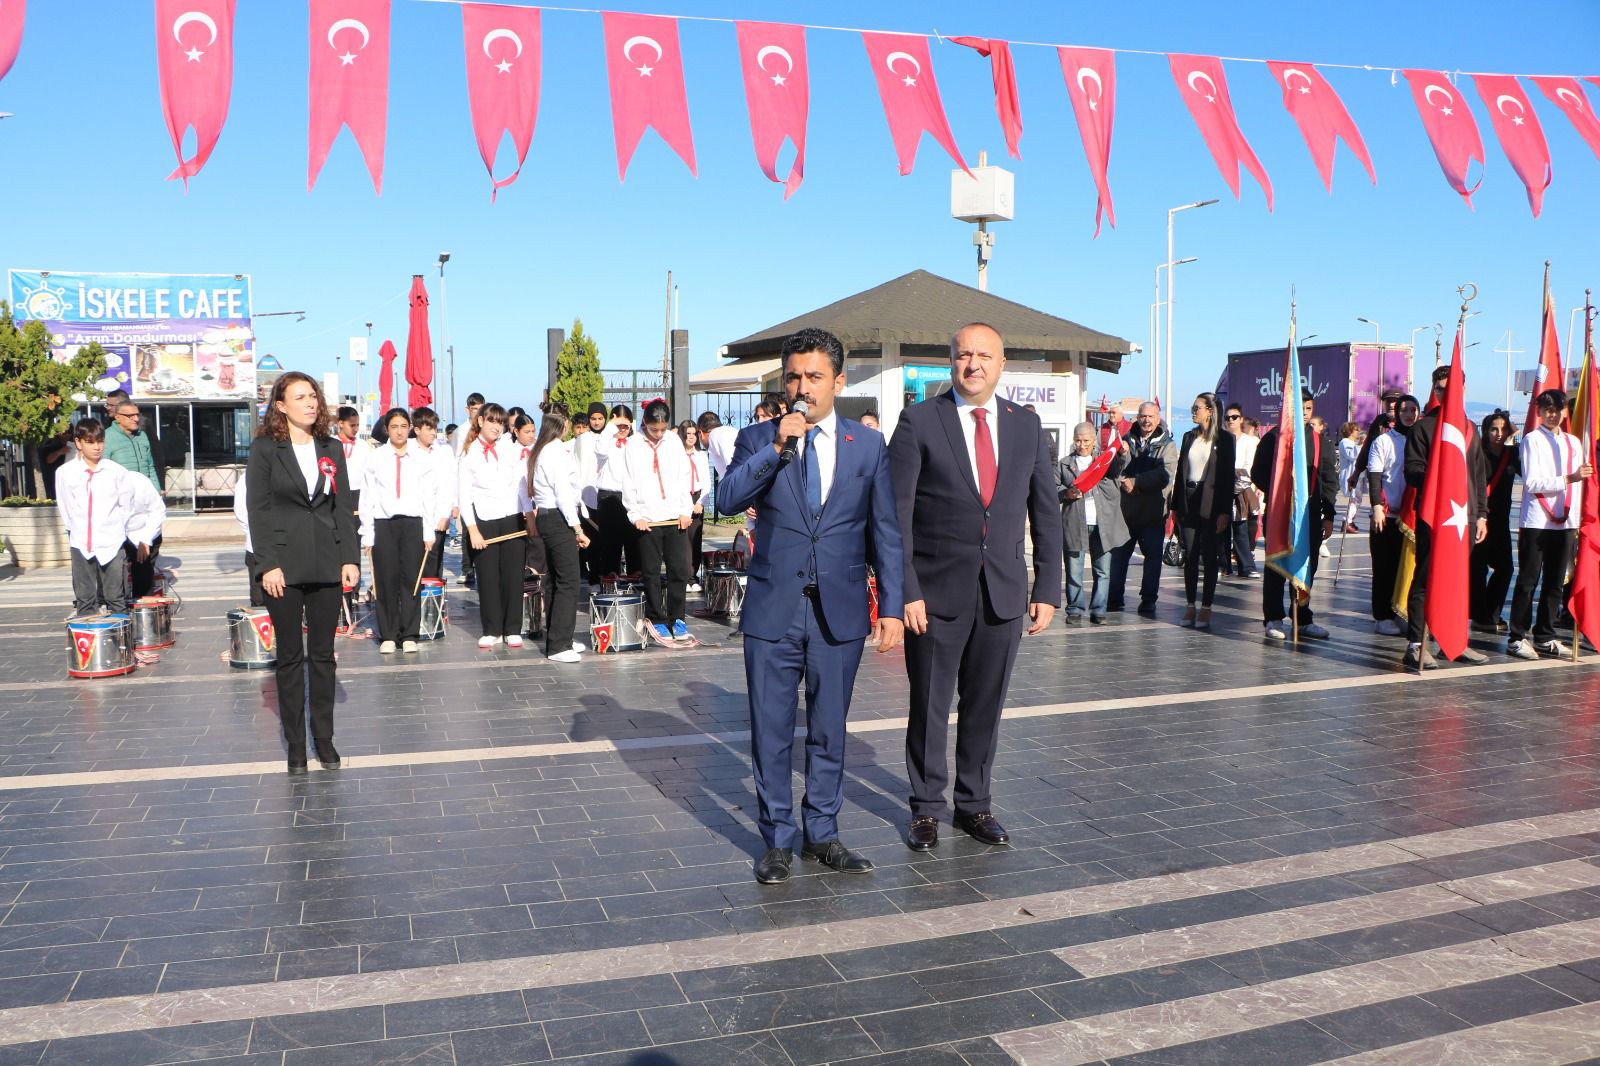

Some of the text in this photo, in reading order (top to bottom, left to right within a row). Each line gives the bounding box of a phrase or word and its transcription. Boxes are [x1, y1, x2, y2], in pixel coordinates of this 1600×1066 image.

[78, 280, 243, 319] İSKELE CAFE
[1006, 385, 1055, 403] VEZNE
